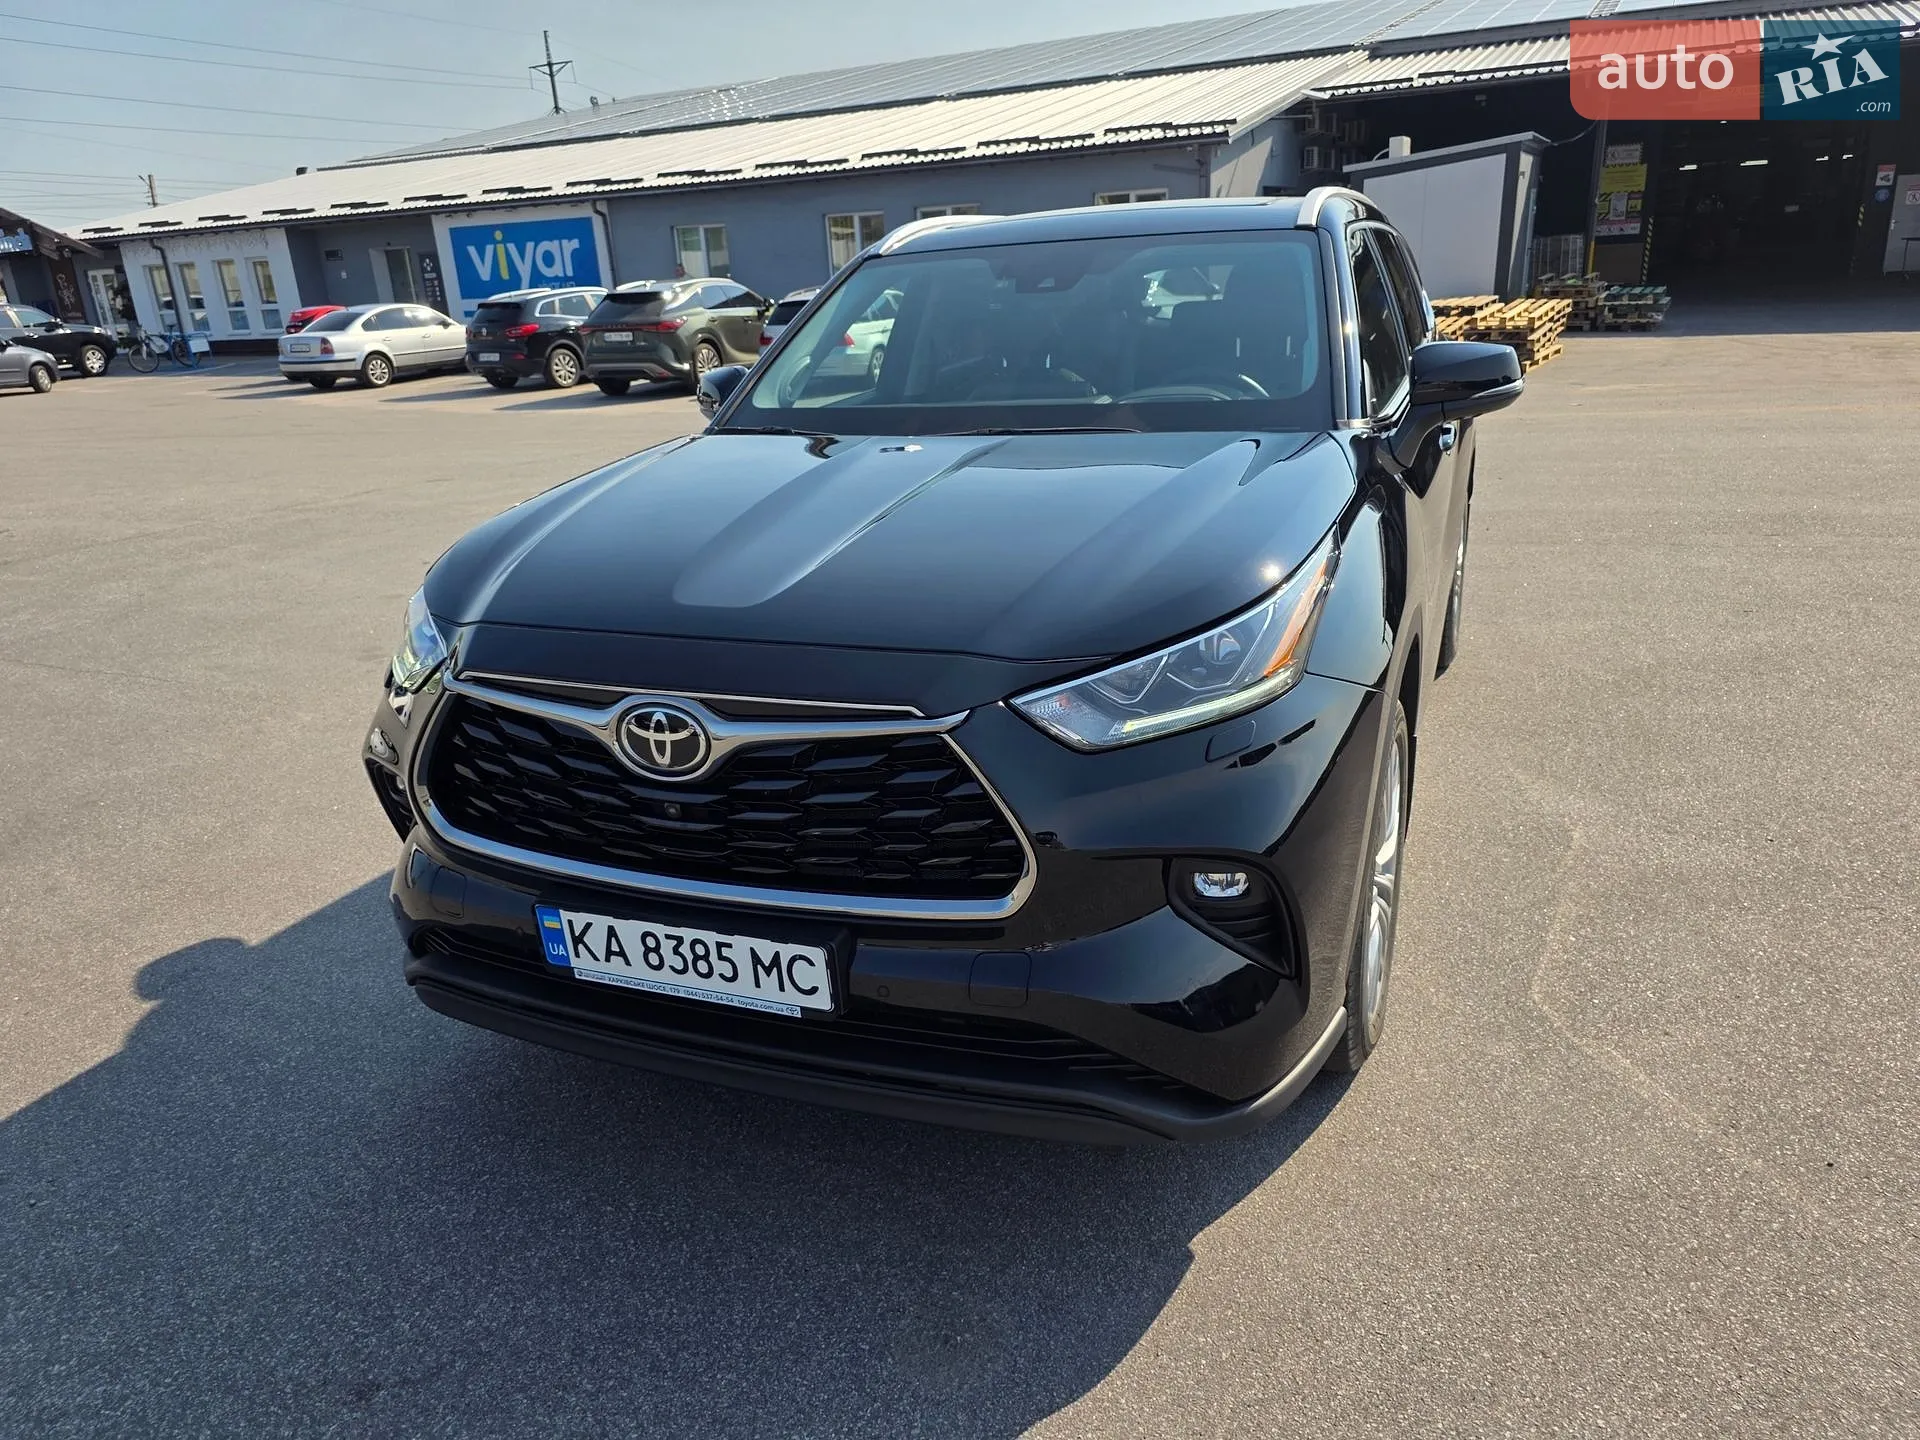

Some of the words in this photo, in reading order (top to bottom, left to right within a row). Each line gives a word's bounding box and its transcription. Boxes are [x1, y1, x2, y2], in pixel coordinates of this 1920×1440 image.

[466, 230, 580, 289] viyar
[549, 942, 568, 957] UA
[567, 918, 632, 967] KA
[640, 930, 739, 983] 8385
[749, 946, 820, 996] MC
